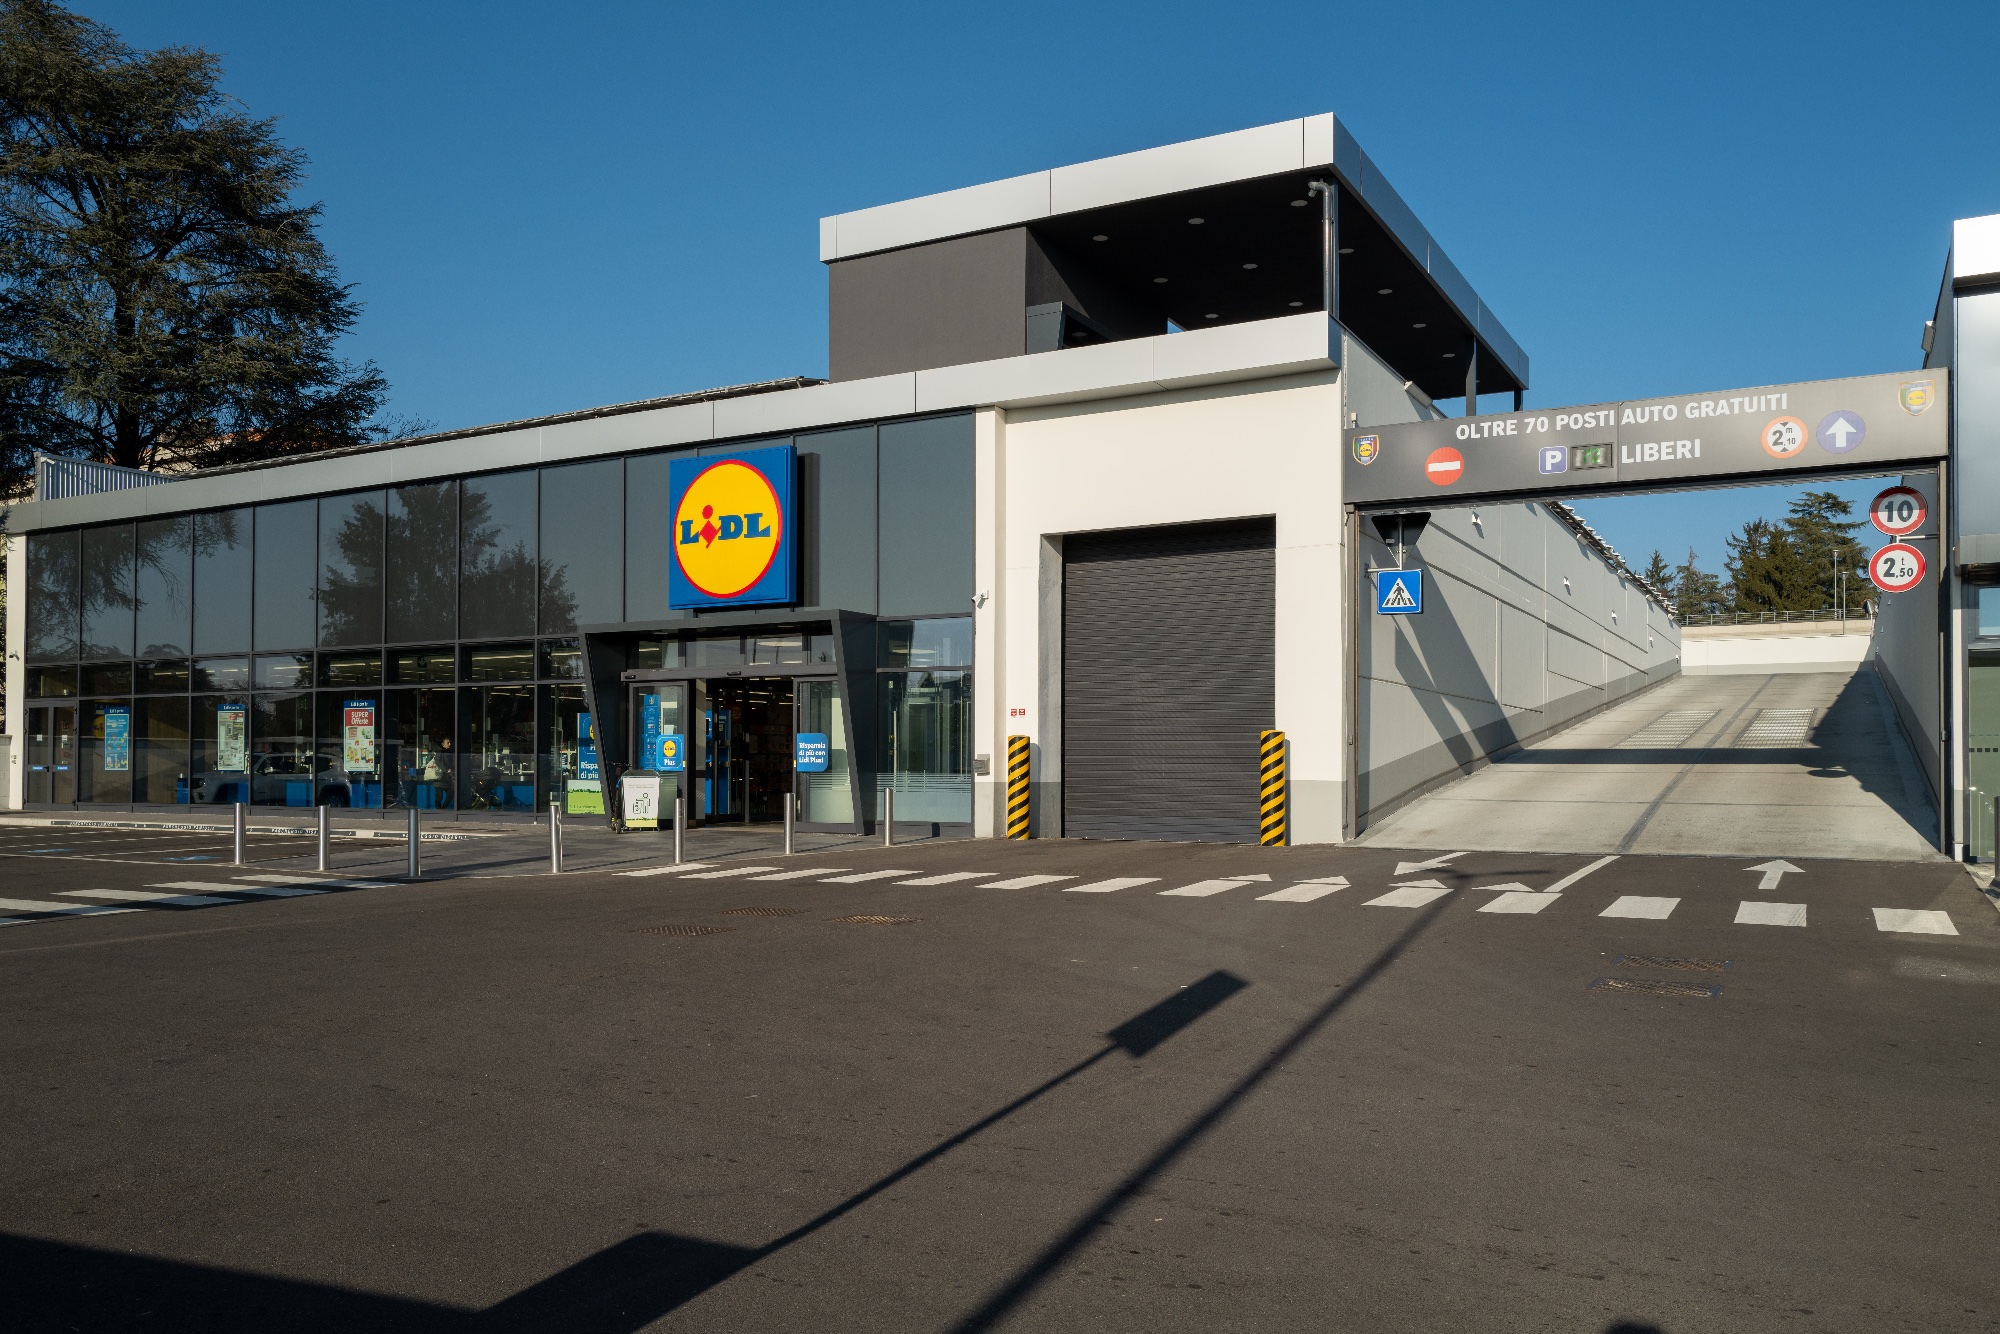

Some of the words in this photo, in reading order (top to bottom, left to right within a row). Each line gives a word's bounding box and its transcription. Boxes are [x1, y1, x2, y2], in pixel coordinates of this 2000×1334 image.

[1456, 419, 1518, 440] OLTRE
[1524, 416, 1549, 434] 70
[1556, 409, 1615, 431] POSTI
[1621, 404, 1678, 425] AUTO
[1685, 393, 1788, 419] GRATUITI
[1545, 450, 1563, 471] P
[1621, 439, 1701, 464] LIBERI
[1884, 499, 1914, 523] 10
[680, 505, 771, 549] LIDL
[1883, 557, 1914, 579] 2,50
[580, 761, 598, 770] Rispa
